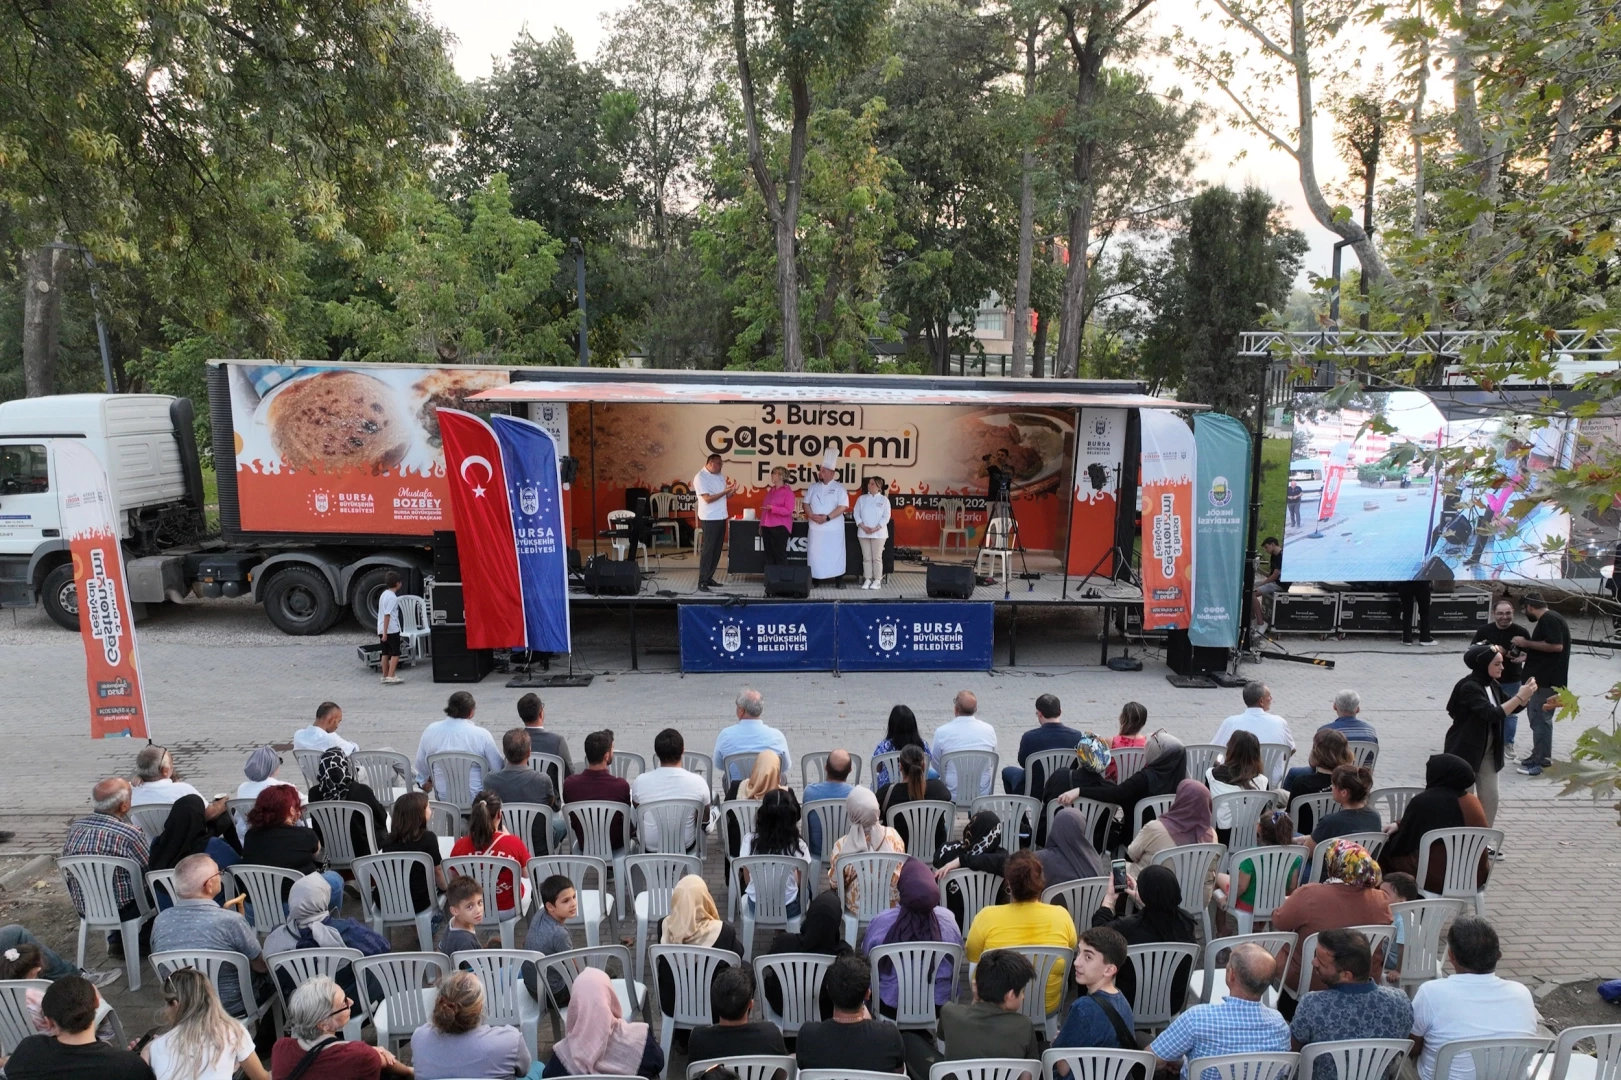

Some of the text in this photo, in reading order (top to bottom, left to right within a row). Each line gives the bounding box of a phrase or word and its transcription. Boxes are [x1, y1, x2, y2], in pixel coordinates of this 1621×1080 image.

[762, 403, 855, 426] 3. Bursa
[758, 461, 856, 485] Fstivali
[338, 493, 374, 501] BURSA
[398, 487, 433, 500] Mustafa
[393, 498, 442, 508] BOZBEY
[895, 497, 905, 506] 13
[912, 497, 922, 507] 14
[929, 498, 939, 507] 15
[965, 498, 987, 508] 202
[516, 527, 554, 538] URSA
[516, 537, 555, 546] ÜYÜKŞEHİR
[516, 544, 556, 554] ELEDİYESİ
[757, 623, 807, 635] BURSA
[913, 622, 963, 633] BURSA
[757, 634, 808, 645] BÜYÜKŞEHİR
[913, 633, 963, 644] BÜYÜKŞEHİR
[757, 642, 808, 651] BELEDİYESİ
[913, 641, 963, 651] BELEDİYESİ
